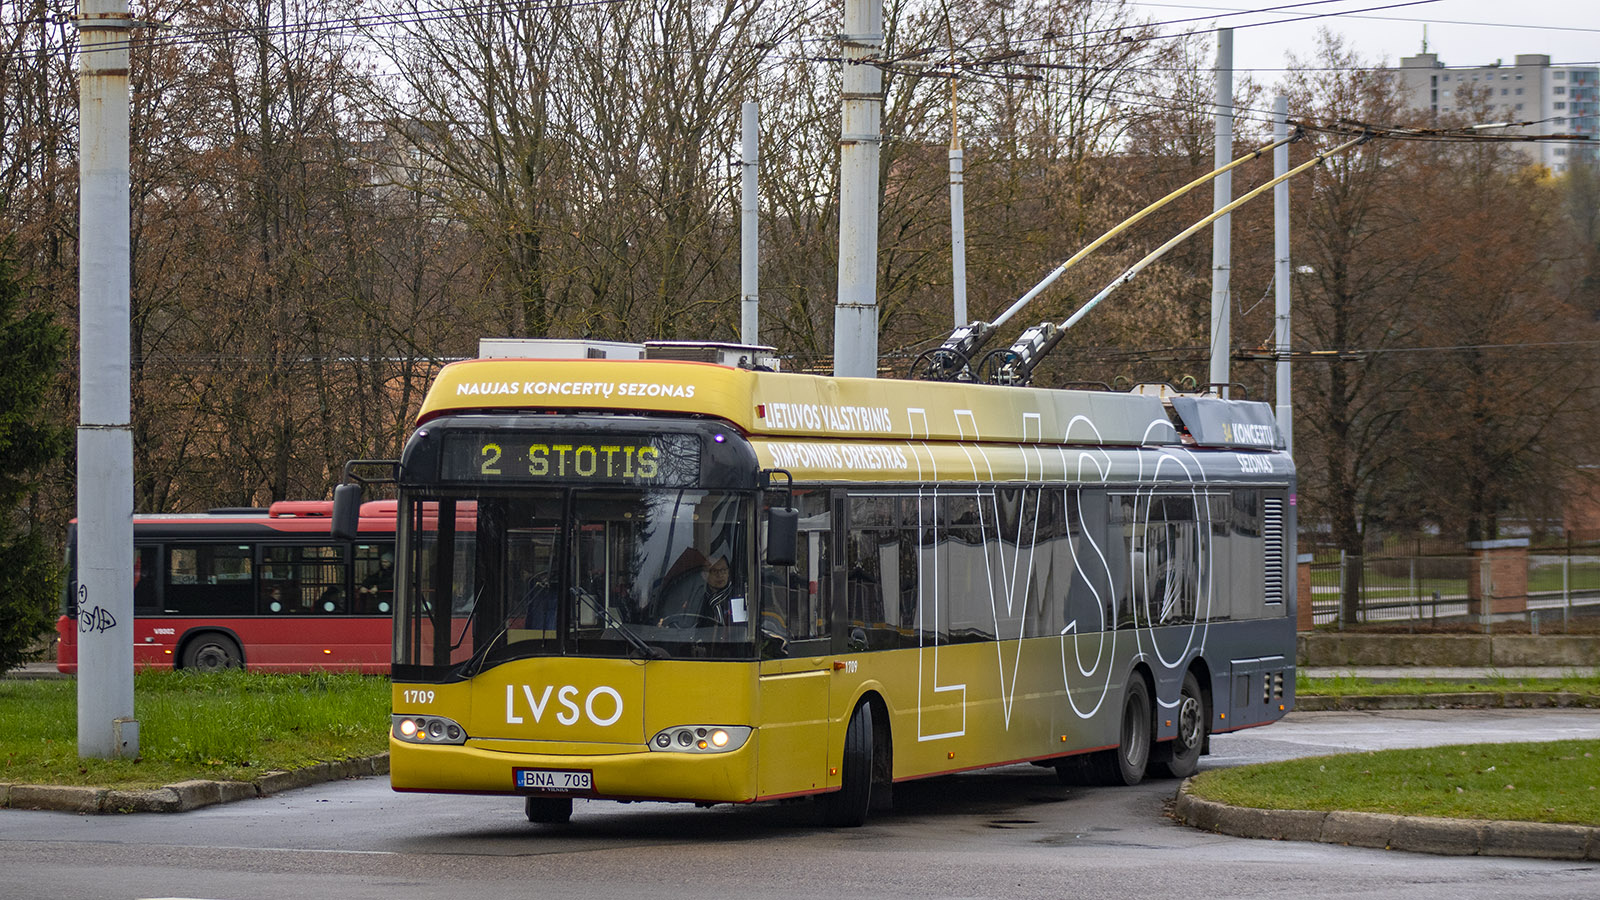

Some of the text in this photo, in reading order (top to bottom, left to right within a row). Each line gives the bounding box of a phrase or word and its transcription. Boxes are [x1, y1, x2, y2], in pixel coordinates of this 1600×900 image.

[456, 381, 696, 399] NAUJAS KONCERTŲ SEZONAS
[762, 402, 893, 433] LIETUVOS VALSTYBINIS
[480, 443, 659, 478] 2 STOTIS
[767, 442, 908, 470] SIMFONINIS ORKESTRAS
[1235, 453, 1274, 474] SEZONAS
[907, 408, 1212, 742] LVSO
[845, 660, 858, 674] 1709
[403, 690, 435, 704] 1709
[505, 684, 624, 727] LVSO
[525, 772, 555, 786] BNA
[564, 773, 589, 787] 709
